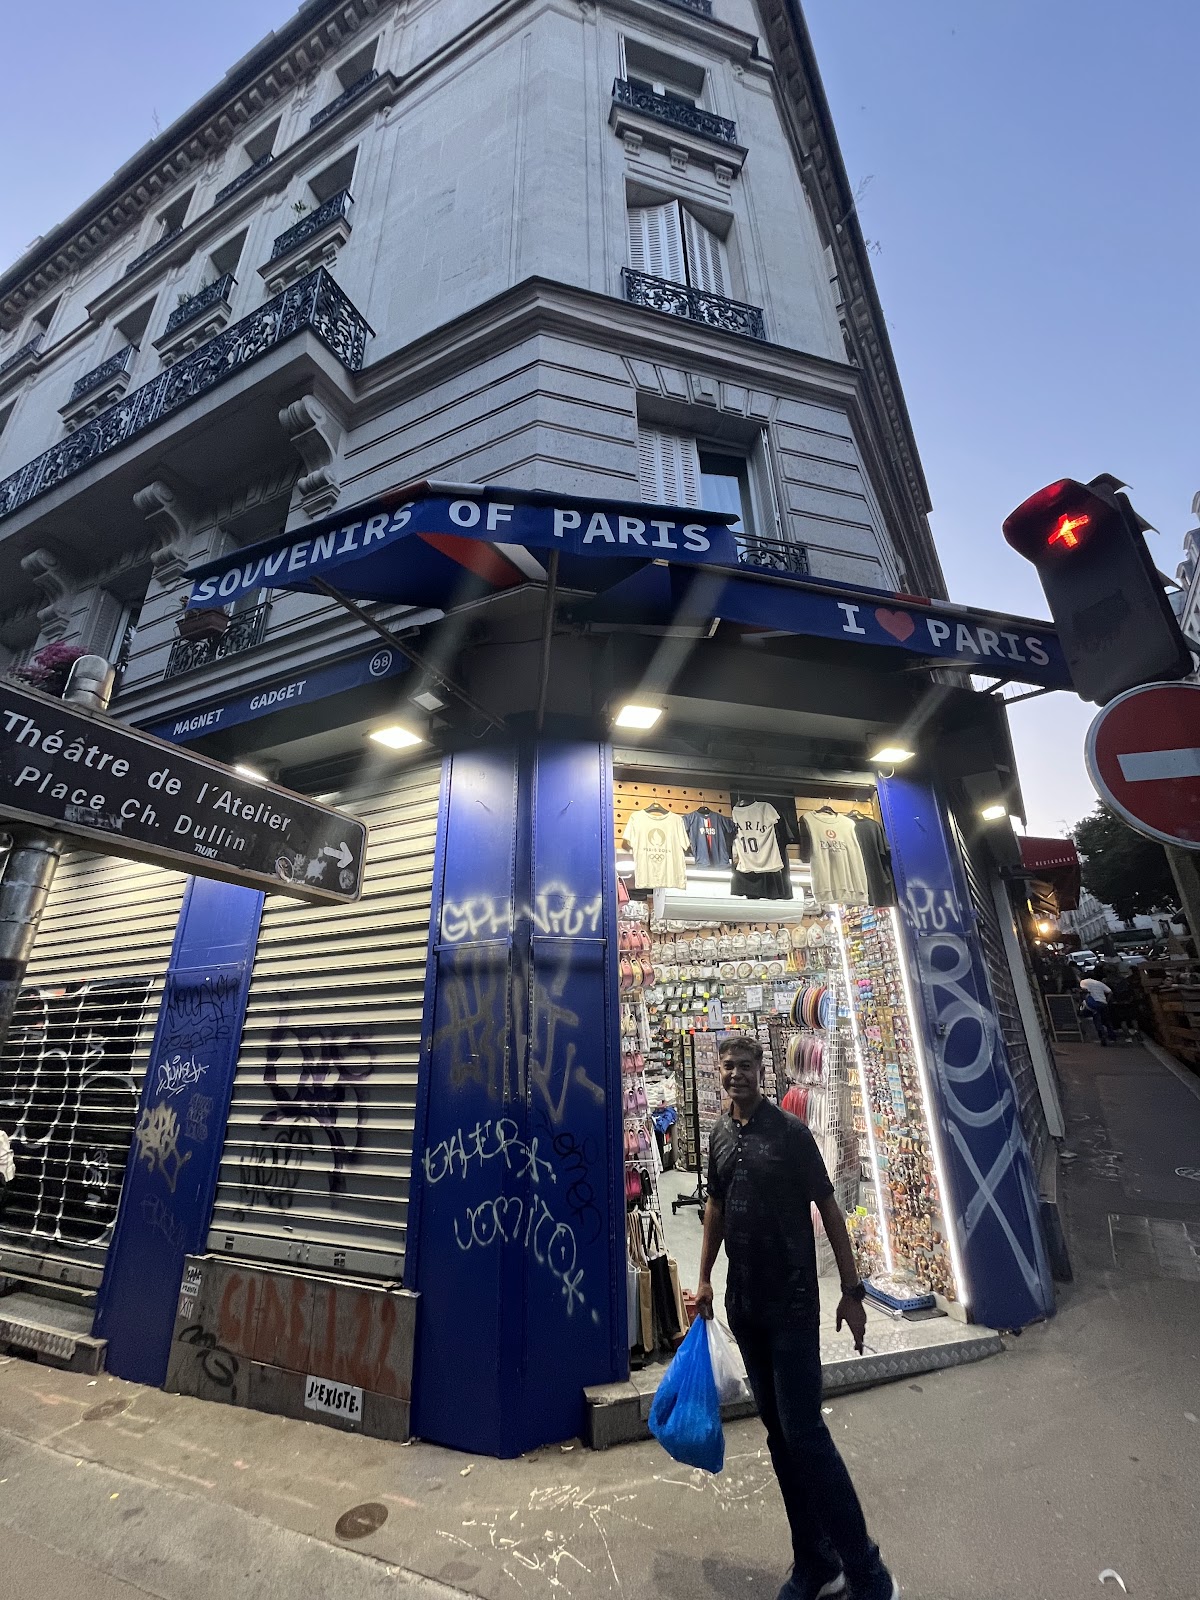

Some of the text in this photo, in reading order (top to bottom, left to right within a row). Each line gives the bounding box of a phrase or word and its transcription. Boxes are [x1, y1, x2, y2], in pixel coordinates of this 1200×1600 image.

[190, 499, 711, 601] SOUVENIRS OF PARIS
[373, 654, 390, 670] 98
[836, 602, 1050, 666] I PARIS
[172, 680, 307, 736] MAGNET GADGET
[2, 709, 131, 778] Théâtre
[147, 768, 182, 795] de
[13, 765, 106, 810] Place
[120, 798, 160, 827] Ch.
[173, 814, 247, 851] Dullin
[736, 820, 768, 834] ARIS
[740, 836, 759, 853] 10
[307, 1381, 359, 1413] J'EXISTE.
